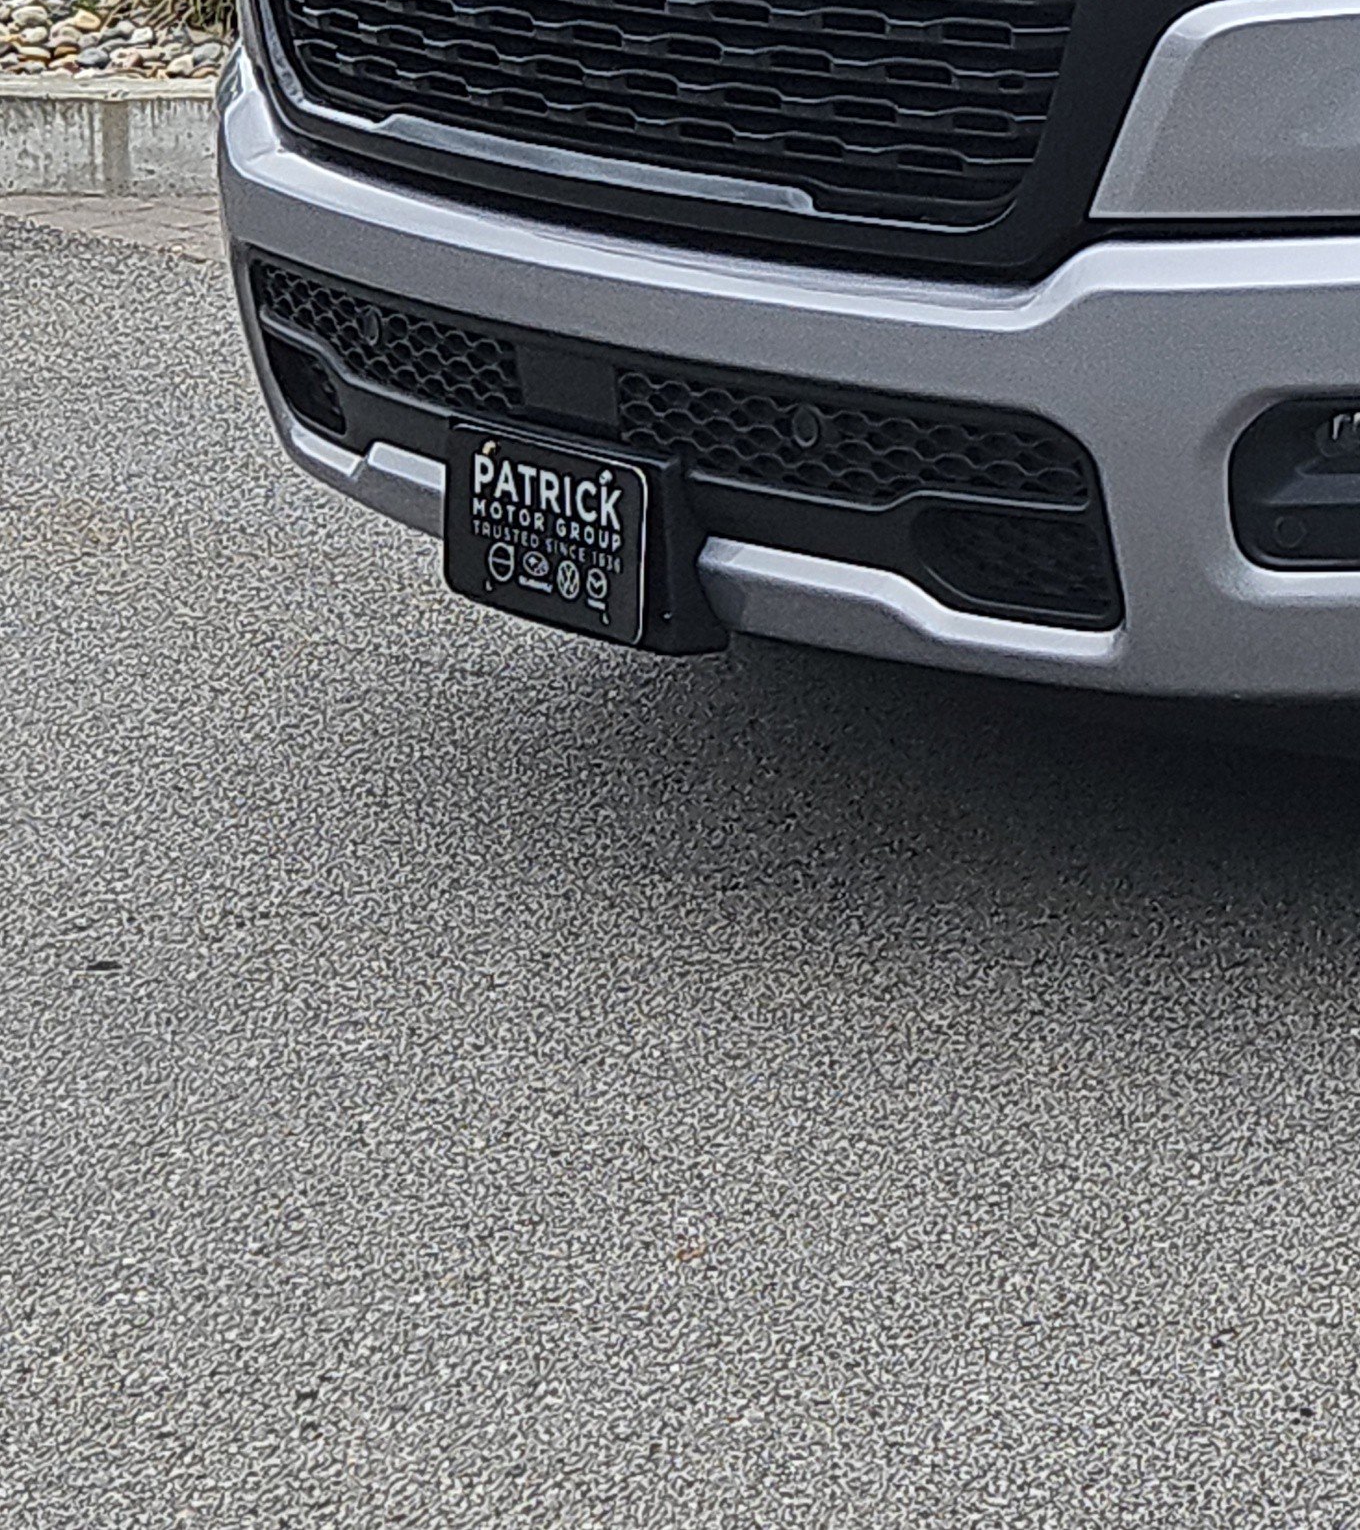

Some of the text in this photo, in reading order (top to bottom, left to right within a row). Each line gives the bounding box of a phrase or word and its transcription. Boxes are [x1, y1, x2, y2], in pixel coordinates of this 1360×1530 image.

[473, 454, 622, 531] PATRICK
[473, 497, 621, 553] MOTOR GROUP
[473, 520, 539, 548] TRUSTED
